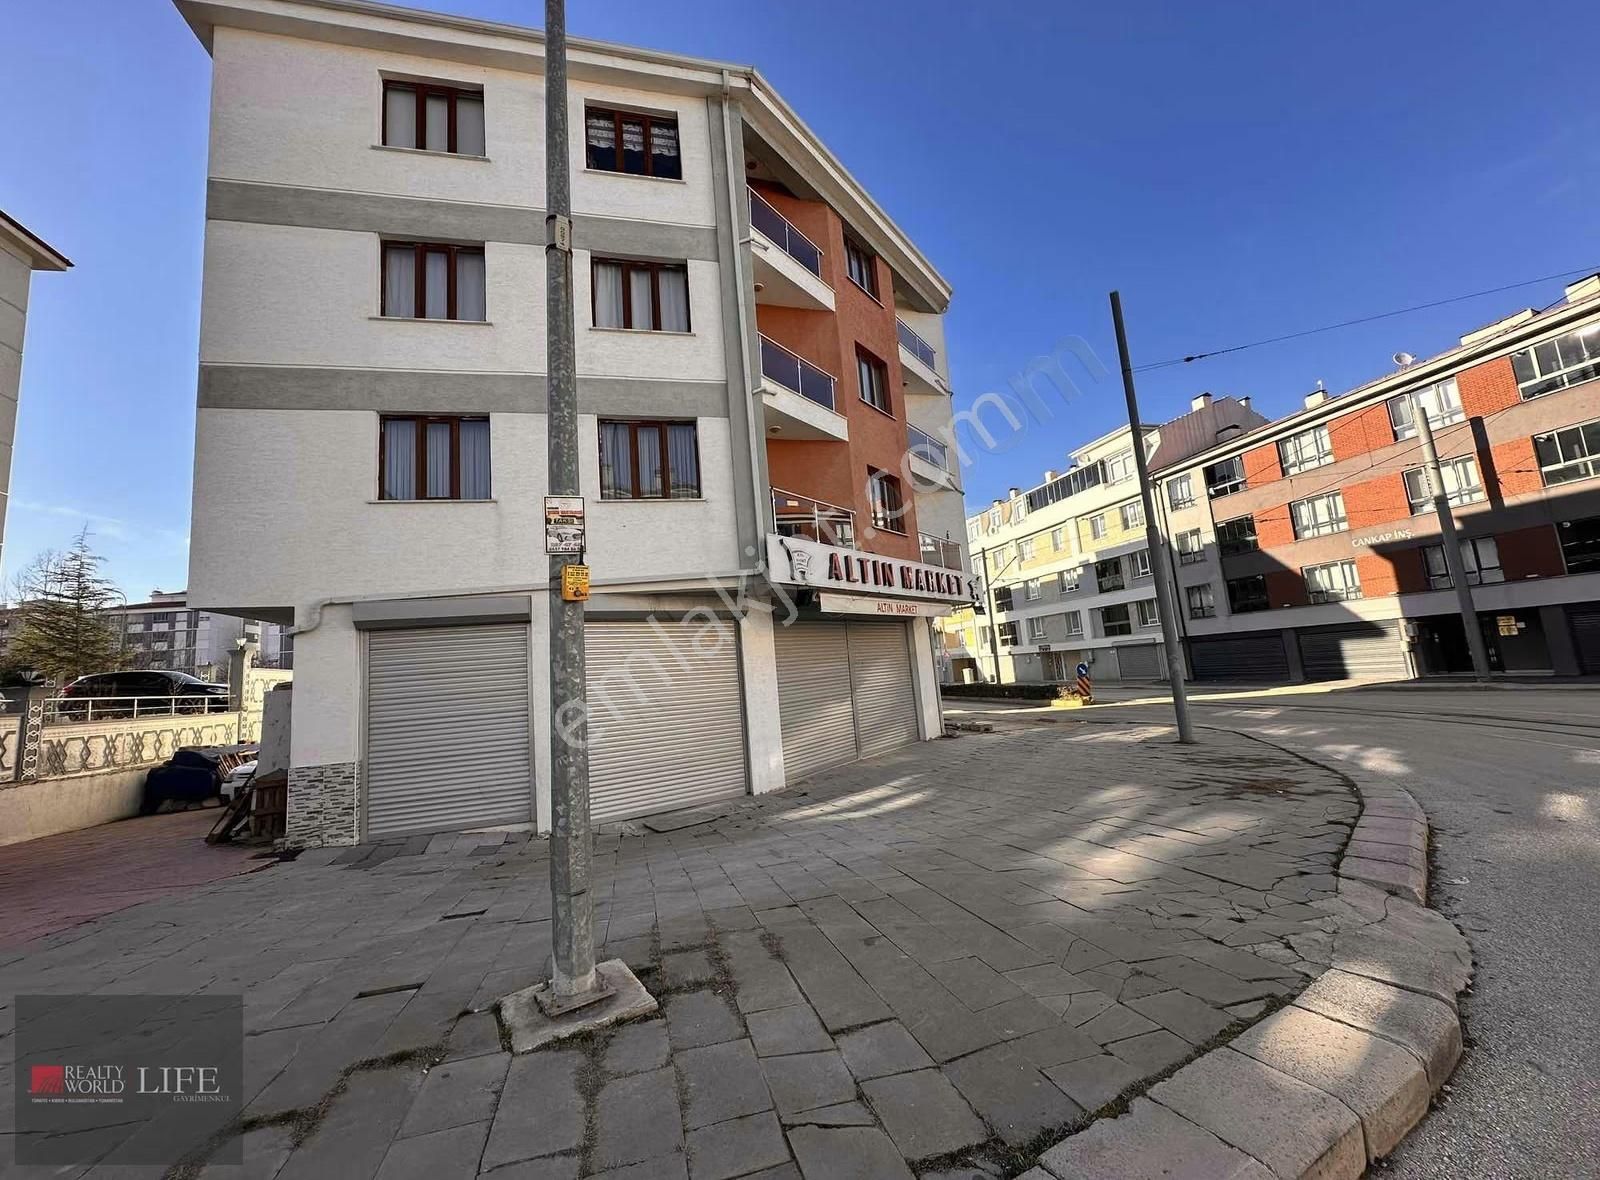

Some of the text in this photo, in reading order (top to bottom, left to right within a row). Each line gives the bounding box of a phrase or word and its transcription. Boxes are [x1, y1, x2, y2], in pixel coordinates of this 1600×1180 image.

[828, 552, 964, 596] ALTIN MARKET
[877, 602, 918, 615] ALTIN MARKET
